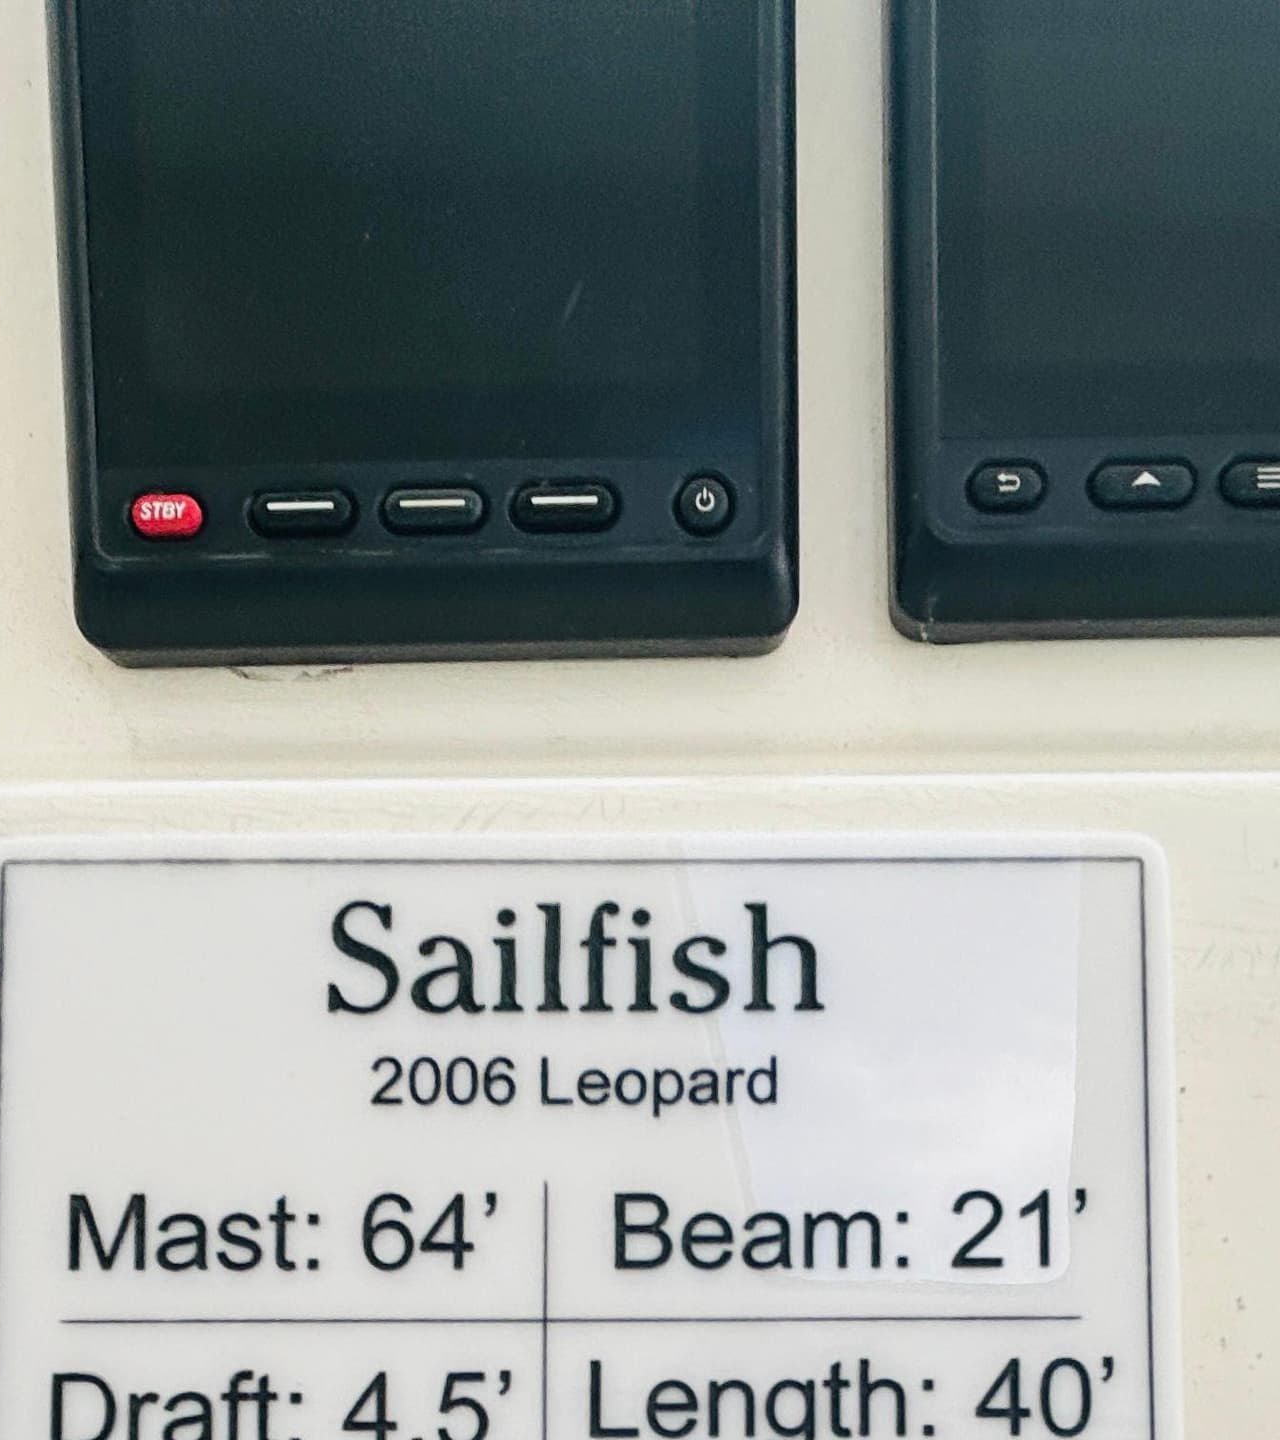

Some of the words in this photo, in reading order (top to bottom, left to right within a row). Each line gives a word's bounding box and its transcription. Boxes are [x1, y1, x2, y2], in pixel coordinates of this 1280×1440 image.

[140, 501, 186, 521] STBY
[326, 899, 826, 1016] Sailfish
[370, 1055, 517, 1107] 2006
[539, 1055, 778, 1119] Leopard
[67, 1192, 321, 1273] Mast:
[361, 1191, 499, 1273] 64’
[613, 1191, 909, 1272] Beam:
[950, 1187, 1090, 1269] 21’
[974, 1355, 1116, 1439] 40’
